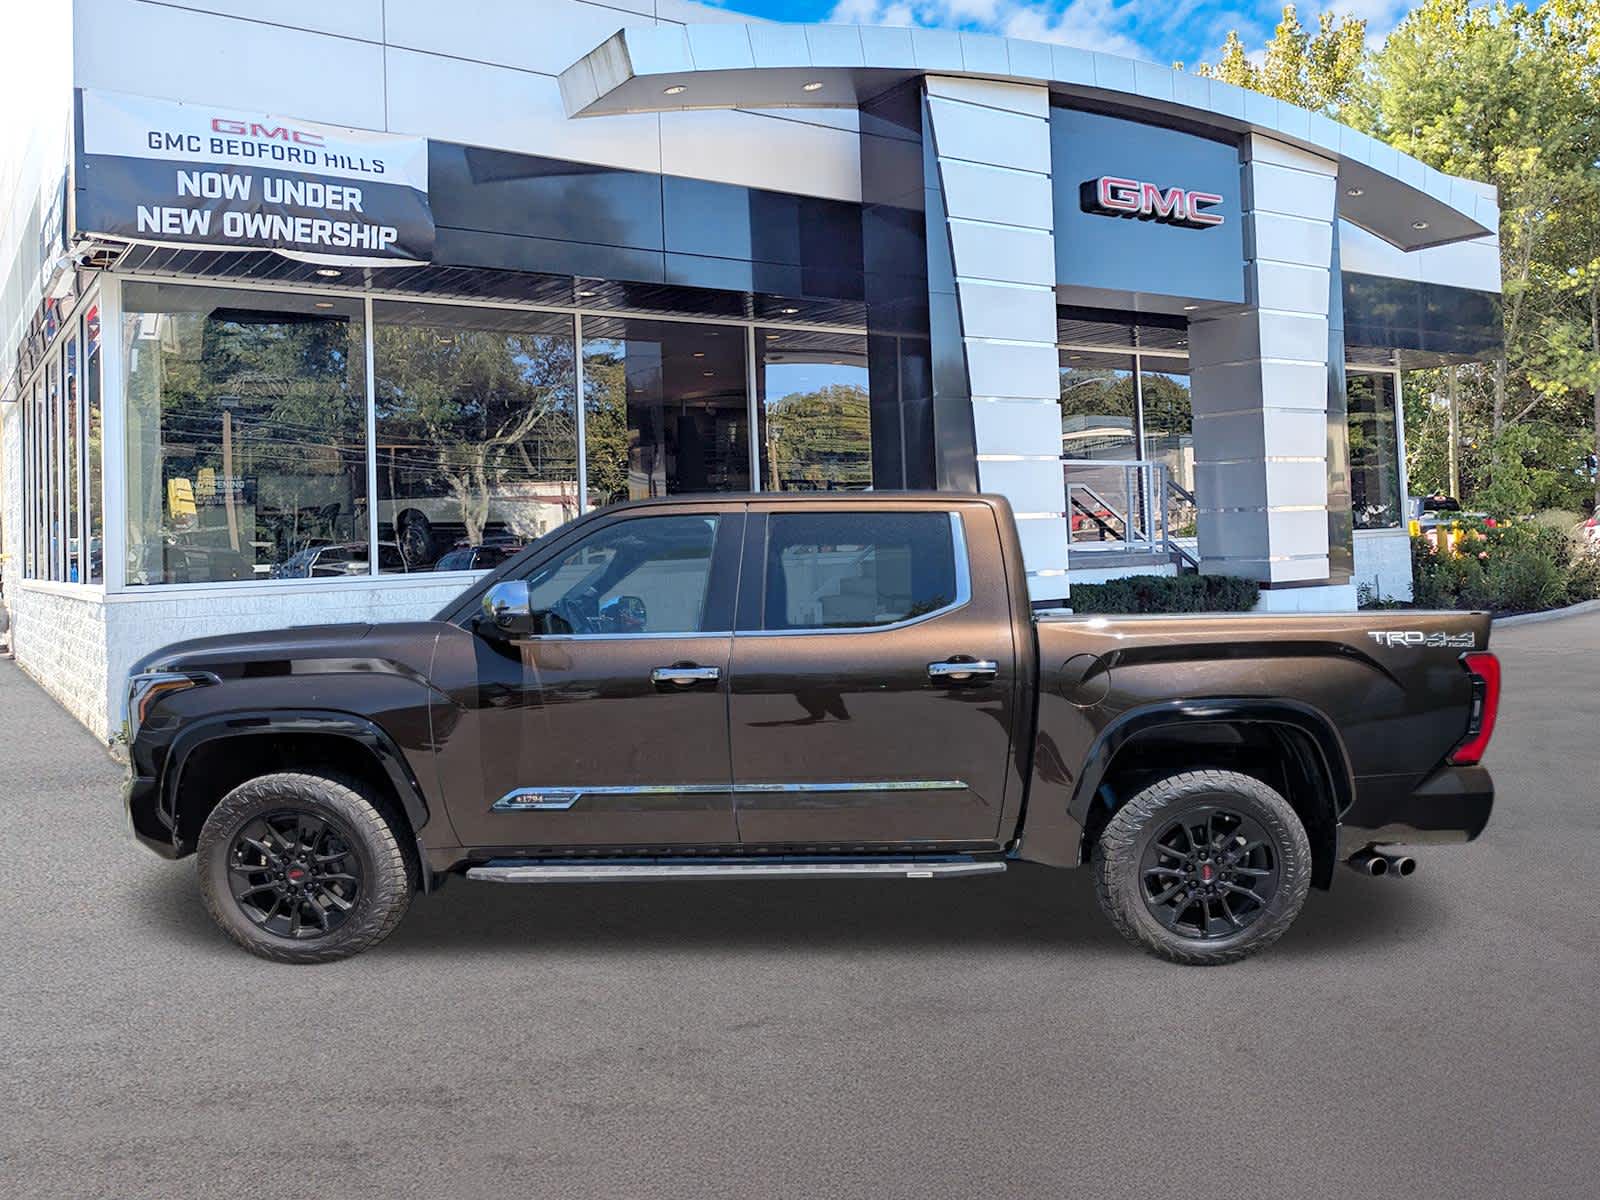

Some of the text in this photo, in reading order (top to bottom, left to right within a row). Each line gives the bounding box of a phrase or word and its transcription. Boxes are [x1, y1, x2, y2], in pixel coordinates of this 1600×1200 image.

[148, 131, 386, 174] GMC BEDFORD HILLS
[210, 118, 326, 148] GMC
[177, 170, 364, 213] NOW UNDER
[1096, 175, 1225, 225] GMC
[136, 205, 398, 251] NEW OWNERSHIP
[1367, 631, 1425, 648] TRD
[522, 795, 544, 803] 1794
